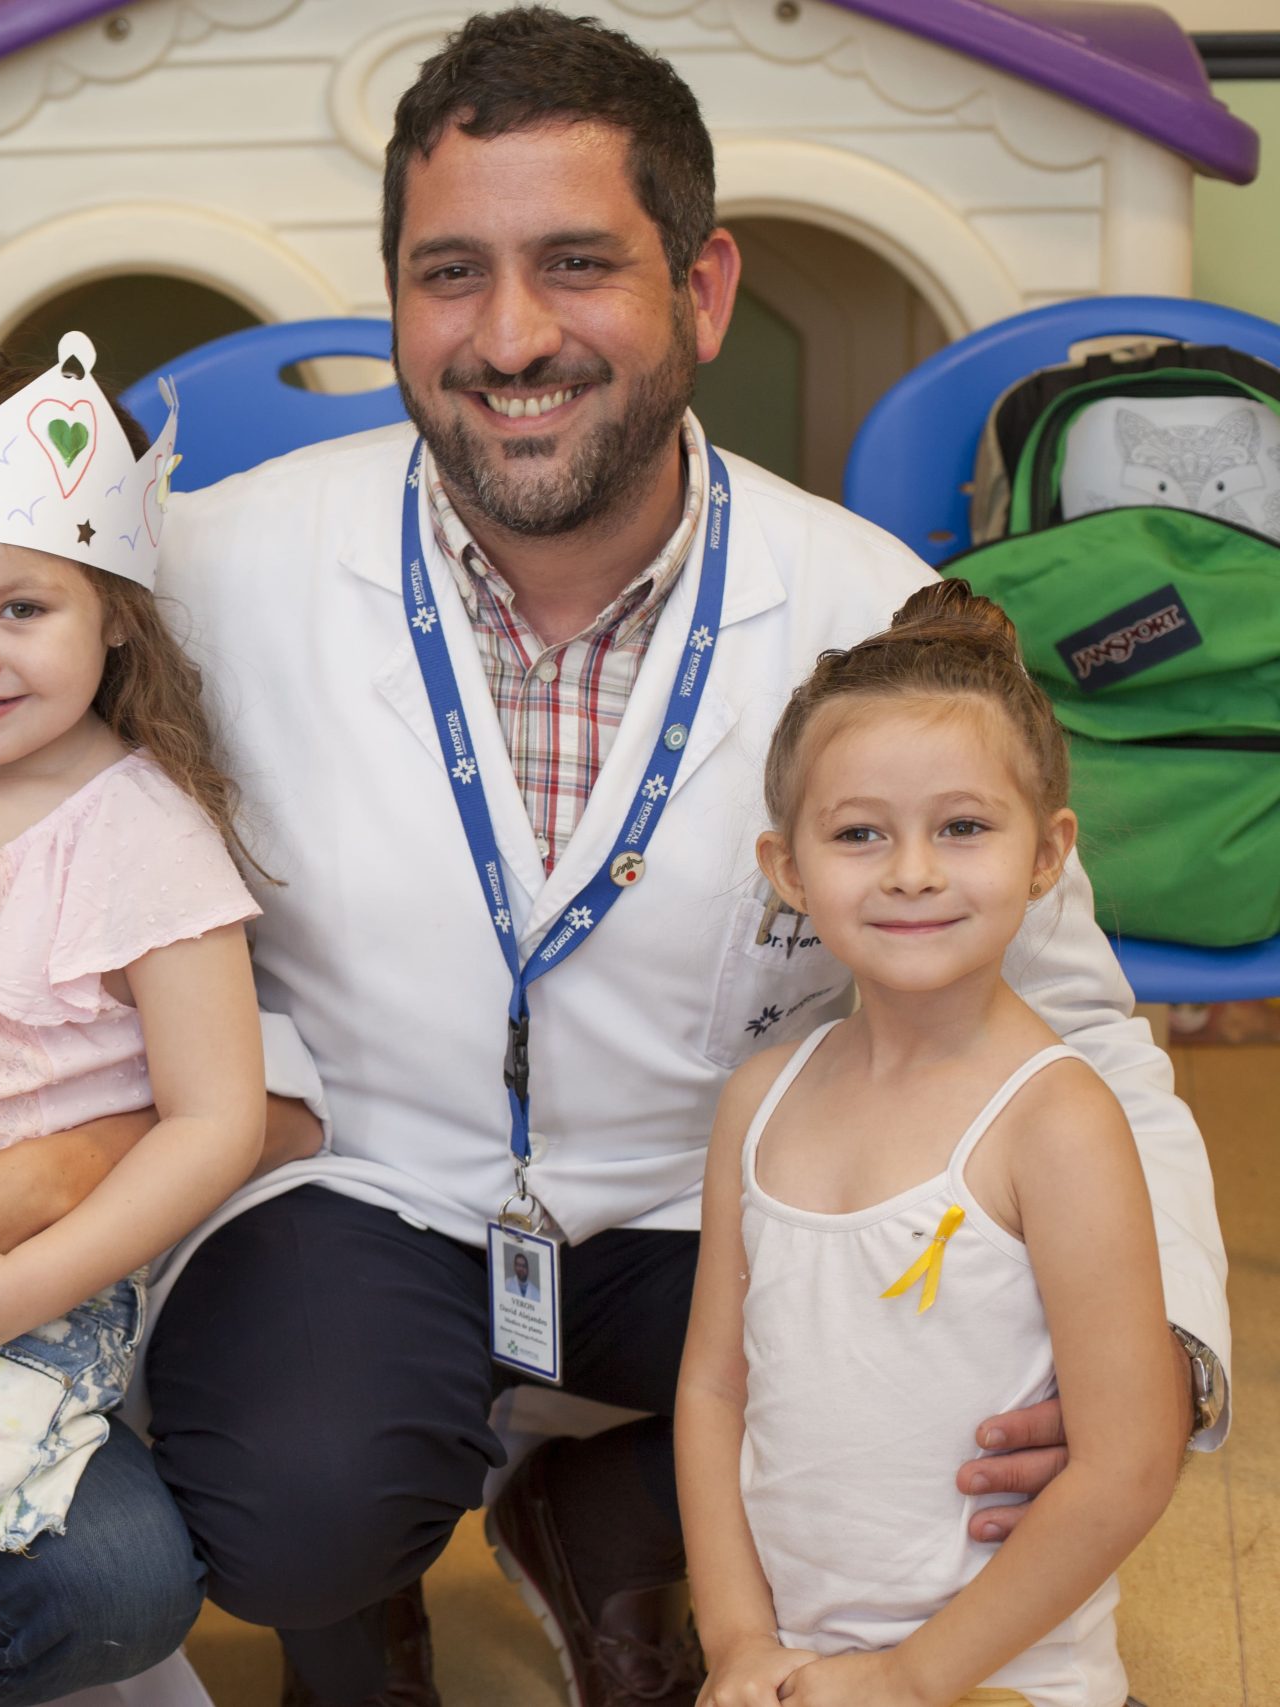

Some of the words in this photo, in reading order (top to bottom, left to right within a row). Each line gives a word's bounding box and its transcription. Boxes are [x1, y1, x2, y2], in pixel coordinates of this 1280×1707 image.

[411, 562, 423, 605] HOSPITAL
[684, 653, 701, 697] HOSPITAL
[446, 713, 464, 756] HOSPITAL
[631, 801, 653, 844] HOSPITAL
[485, 864, 502, 905] HOSPITAL
[544, 927, 575, 962] HOSPITAL
